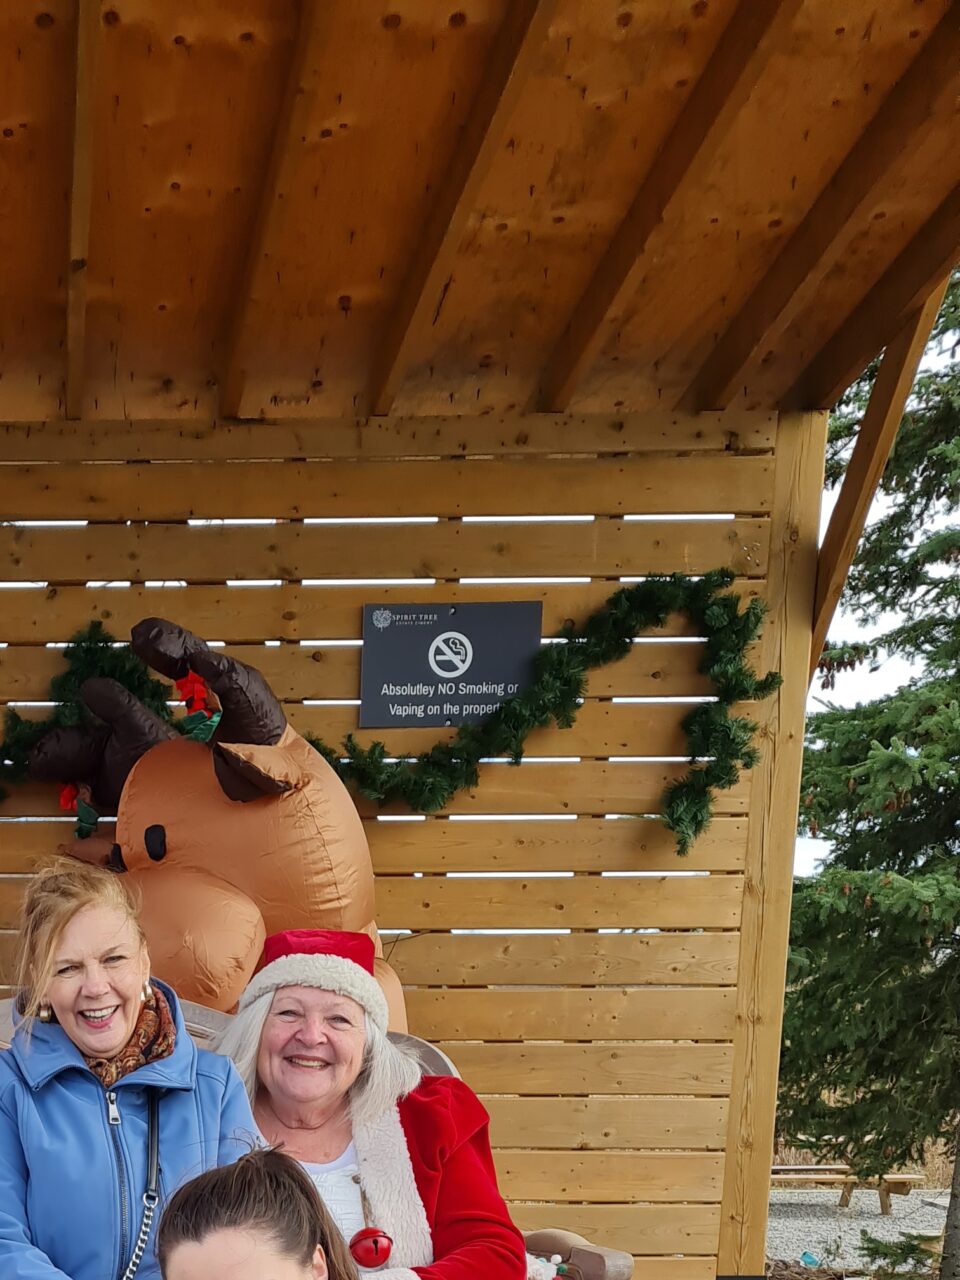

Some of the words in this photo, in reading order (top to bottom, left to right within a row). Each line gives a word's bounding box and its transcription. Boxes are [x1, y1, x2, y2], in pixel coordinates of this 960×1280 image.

[381, 683, 435, 697] Absolutley
[438, 682, 456, 695] NO
[458, 681, 505, 696] Smoking
[507, 683, 519, 694] or
[389, 703, 424, 717] Vaping
[427, 705, 440, 715] on
[443, 702, 459, 714] the
[462, 703, 502, 716] propert
